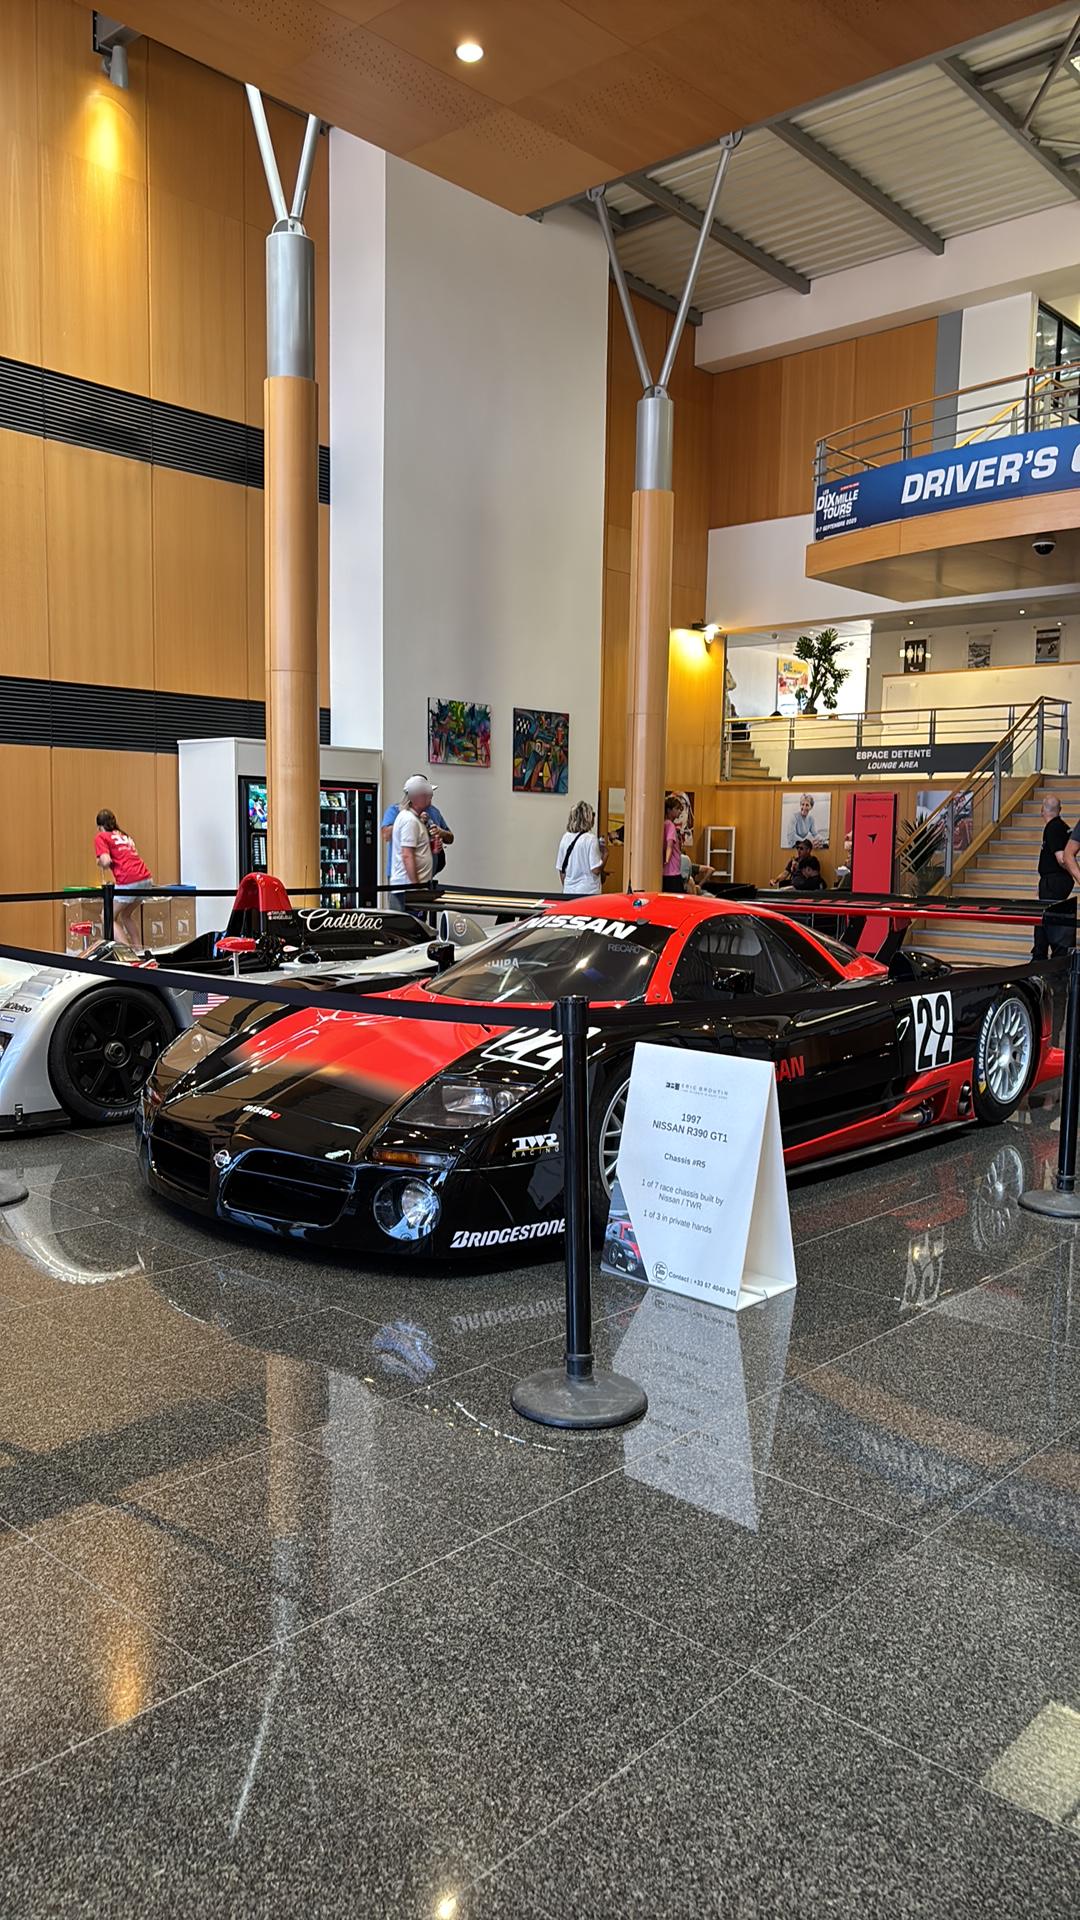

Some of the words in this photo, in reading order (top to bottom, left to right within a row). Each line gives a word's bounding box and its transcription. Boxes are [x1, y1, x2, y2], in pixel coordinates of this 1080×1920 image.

[900, 446, 1059, 505] DRIVER'S
[816, 491, 837, 512] DIX
[834, 489, 860, 505] MILLE
[822, 501, 853, 521] TOURS
[855, 750, 889, 760] ESPACE
[891, 748, 932, 759] DETENTE
[867, 761, 898, 770] LOUNGE
[898, 760, 919, 769] AREA
[297, 908, 384, 932] Cadillac
[517, 914, 638, 940] NISSAN
[917, 993, 950, 1070] 22
[978, 1006, 995, 1070] MICHELIN
[242, 1104, 282, 1120] nismo
[681, 1113, 702, 1125] 1997
[511, 1132, 560, 1151] TWR
[652, 1120, 685, 1134] NISSAN
[686, 1126, 708, 1139] R390
[709, 1131, 728, 1143] GT1
[511, 1147, 560, 1158] RACING
[664, 1152, 691, 1166] Chassis
[691, 1160, 706, 1169] #R5
[641, 1178, 646, 1187] 1
[647, 1179, 654, 1188] of
[655, 1182, 659, 1190] 7
[660, 1184, 674, 1194] race
[674, 1187, 699, 1200] chassis
[699, 1193, 715, 1204] built
[715, 1196, 725, 1207] by
[658, 1193, 681, 1205] Nissan
[686, 1199, 702, 1211] TWR
[449, 1217, 566, 1248] BRIDGESTONE
[643, 1209, 648, 1218] 1
[648, 1210, 656, 1220] of
[656, 1212, 661, 1221] 3
[662, 1213, 668, 1223] in
[668, 1216, 691, 1230] private
[691, 1222, 712, 1235] hands
[668, 1271, 690, 1284] Contact
